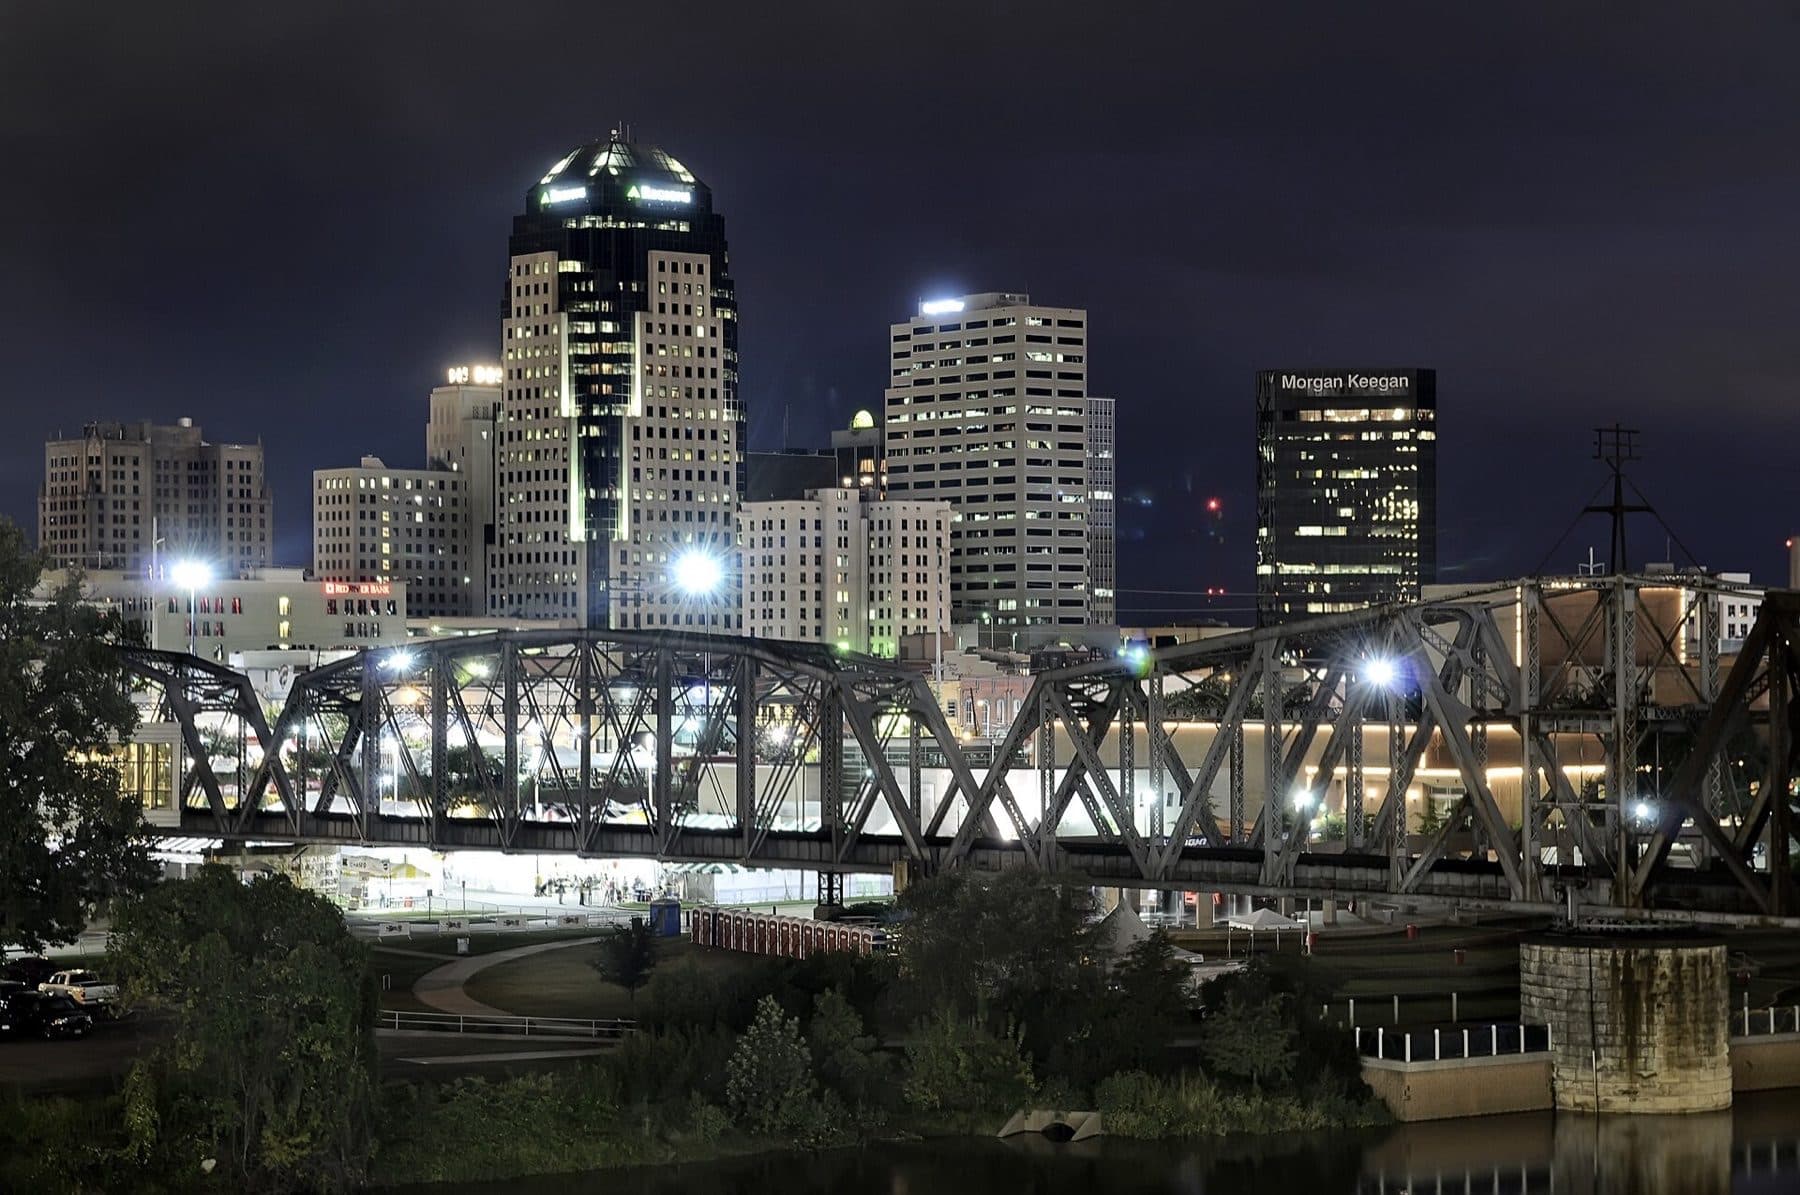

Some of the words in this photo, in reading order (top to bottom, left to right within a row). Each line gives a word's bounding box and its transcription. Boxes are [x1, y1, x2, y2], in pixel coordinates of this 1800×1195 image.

[1282, 375, 1343, 392] Morgan
[1348, 374, 1409, 391] Keegan
[335, 584, 349, 594] RED
[370, 584, 389, 594] BANK
